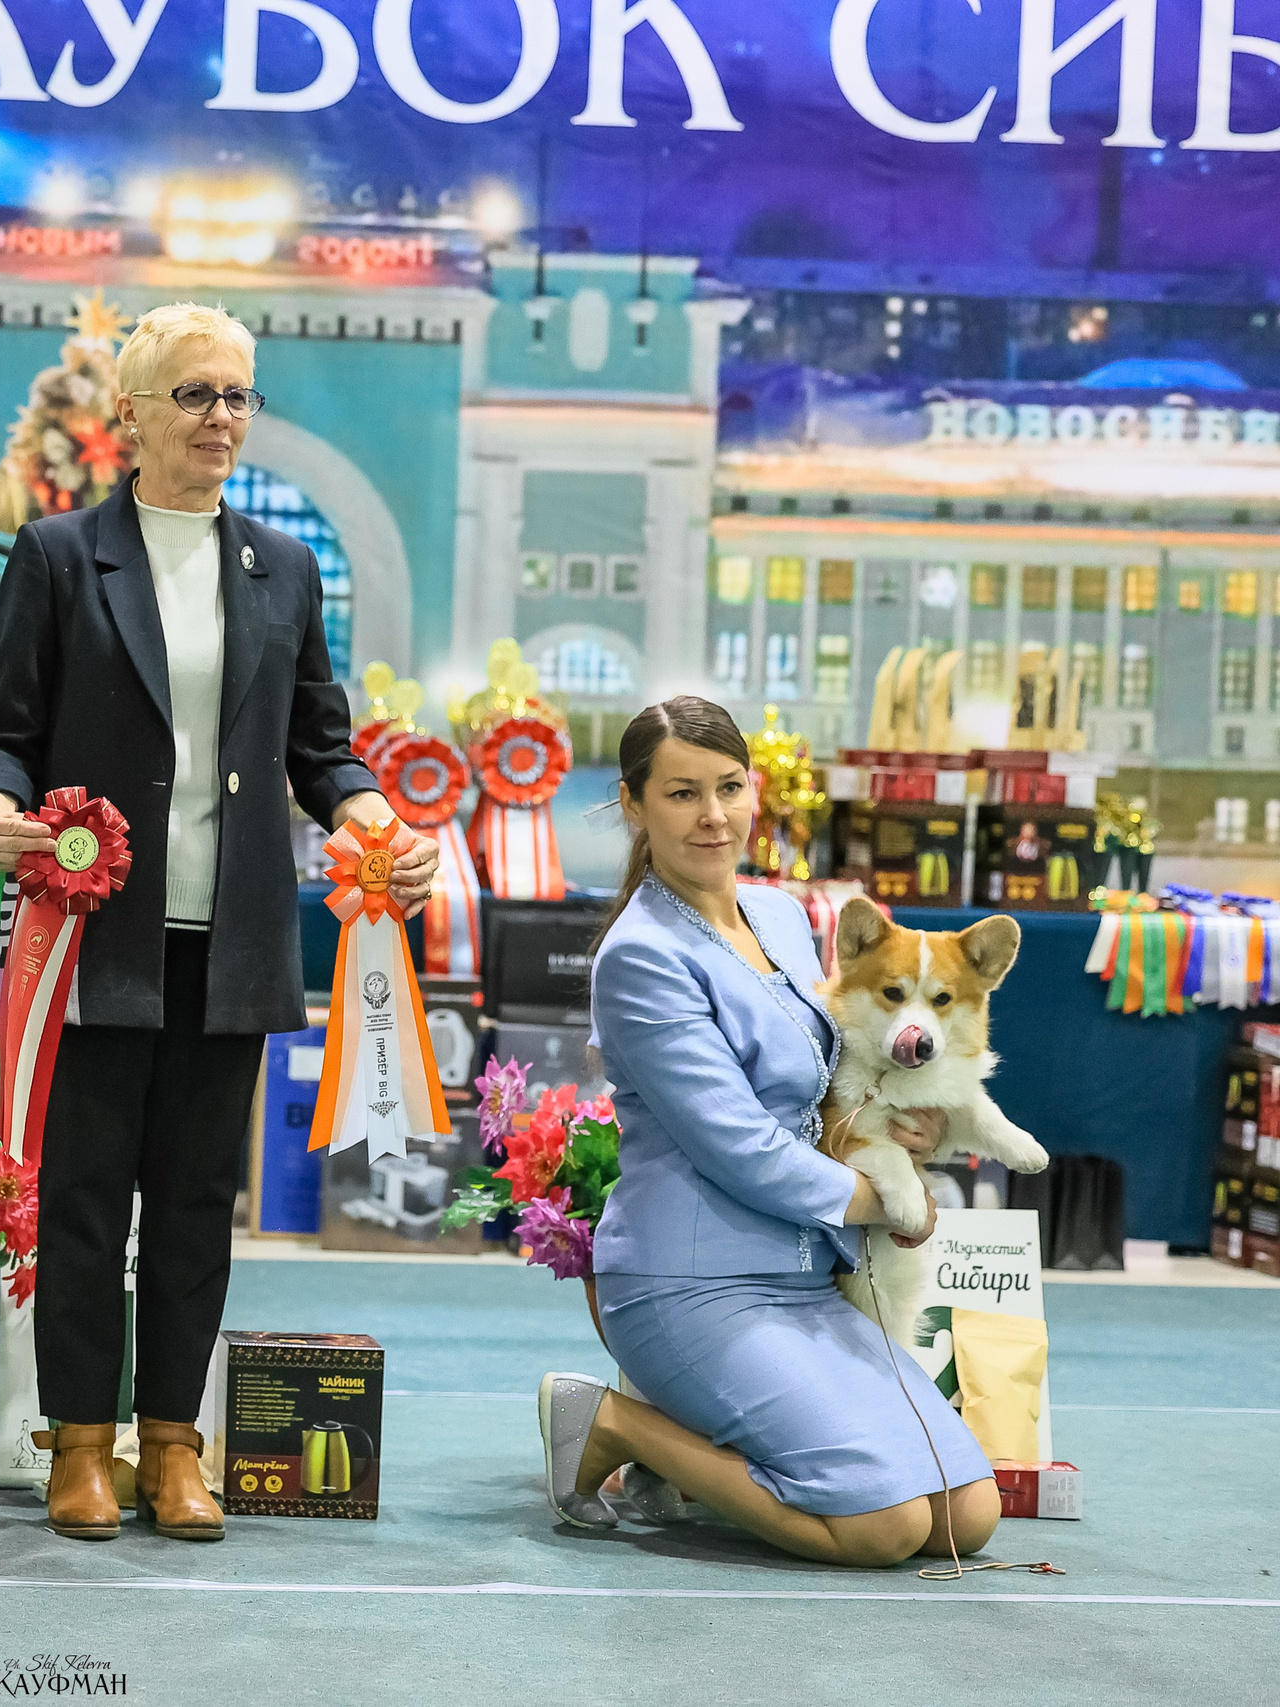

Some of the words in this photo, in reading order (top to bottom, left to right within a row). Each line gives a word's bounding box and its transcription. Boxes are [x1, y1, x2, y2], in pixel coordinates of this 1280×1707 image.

[375, 1037, 388, 1076] ПРИЗЁР
[378, 1080, 388, 1098] BIG
[937, 1262, 1031, 1303] Сибири
[318, 1375, 365, 1388] ЧАЙНИК
